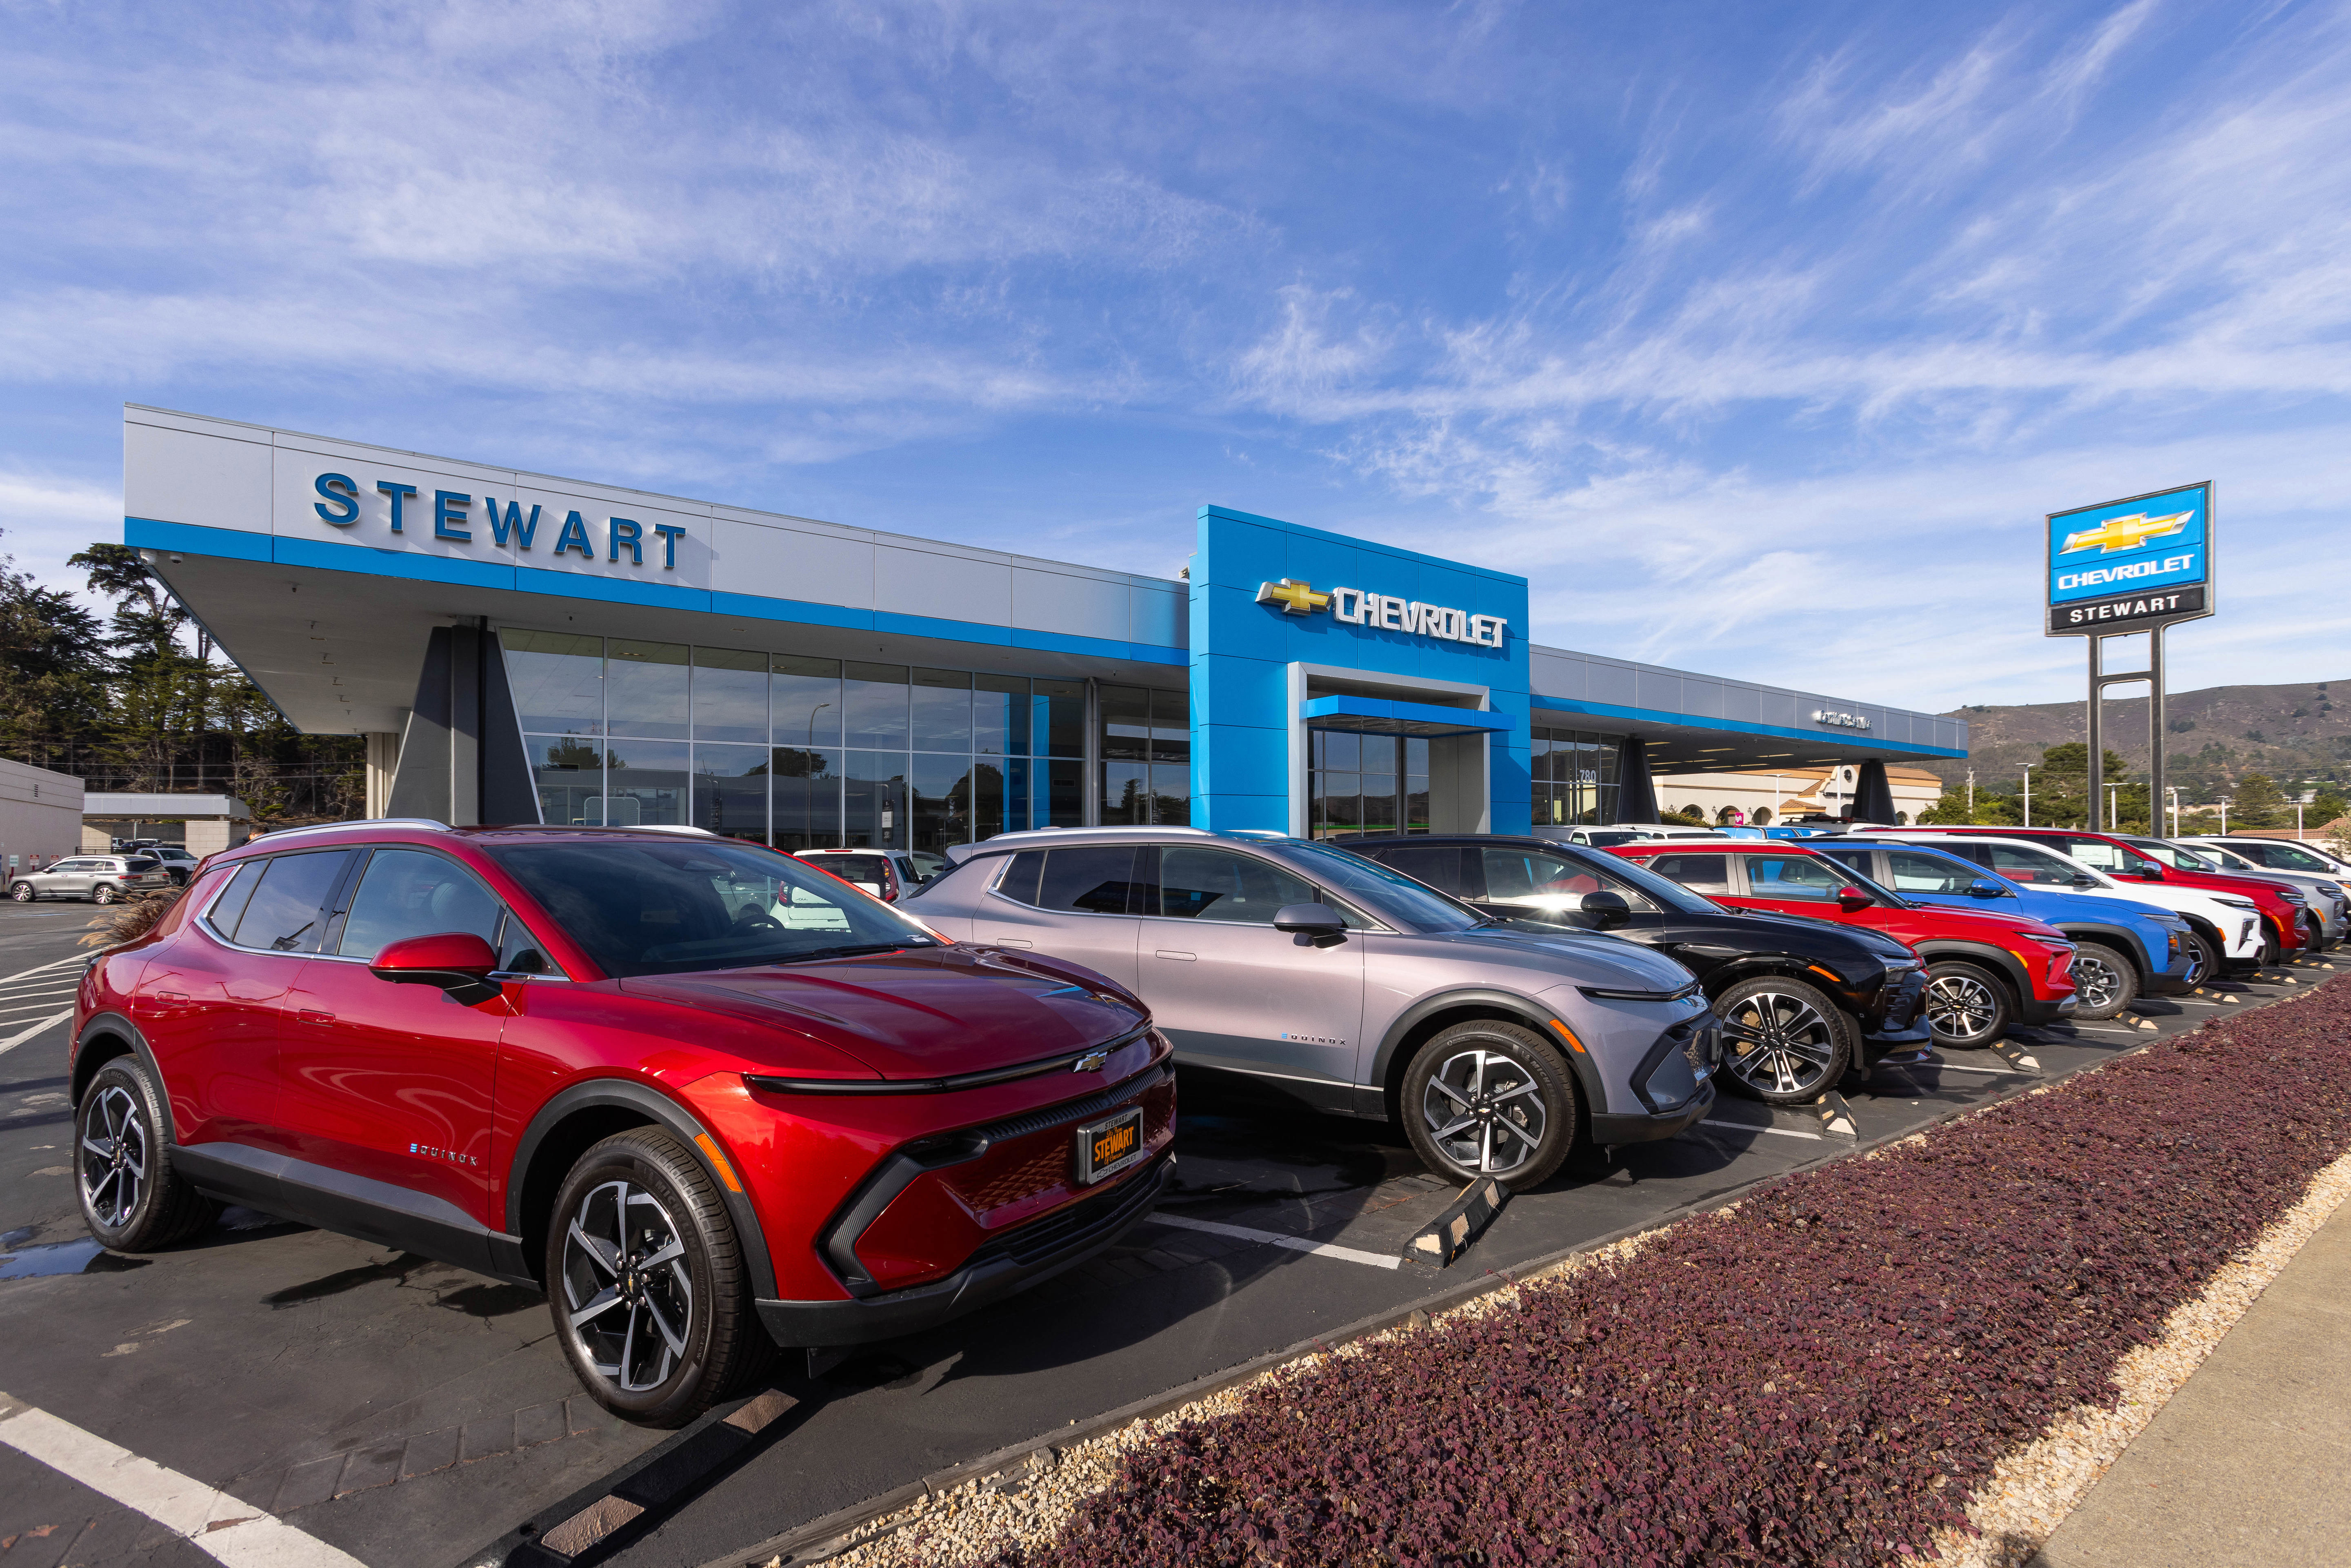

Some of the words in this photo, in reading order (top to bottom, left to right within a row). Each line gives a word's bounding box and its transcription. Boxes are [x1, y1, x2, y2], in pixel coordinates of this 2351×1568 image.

[314, 472, 687, 568] STEWART
[2058, 554, 2195, 589] CHEVROLET
[1333, 586, 1507, 648] CHEVROLET
[2070, 595, 2180, 623] STEWART
[1820, 710, 1847, 726] Certified
[1849, 715, 1872, 729] Service
[1580, 770, 1596, 782] 780
[1755, 984, 1800, 993] PremiumContact
[1281, 1033, 1346, 1045] EQUINOX
[111, 1071, 136, 1094] MICHELIN
[1105, 1113, 1128, 1129] STEWART
[1114, 1126, 1122, 1135] From
[410, 1143, 478, 1166] EQUINOX
[1095, 1126, 1134, 1162] STEWART
[1109, 1154, 1136, 1172] CHEVROLET
[655, 1180, 696, 1248] MICHELIN
[696, 1264, 707, 1312] PRIMACY
[697, 1332, 705, 1360] SEASON
